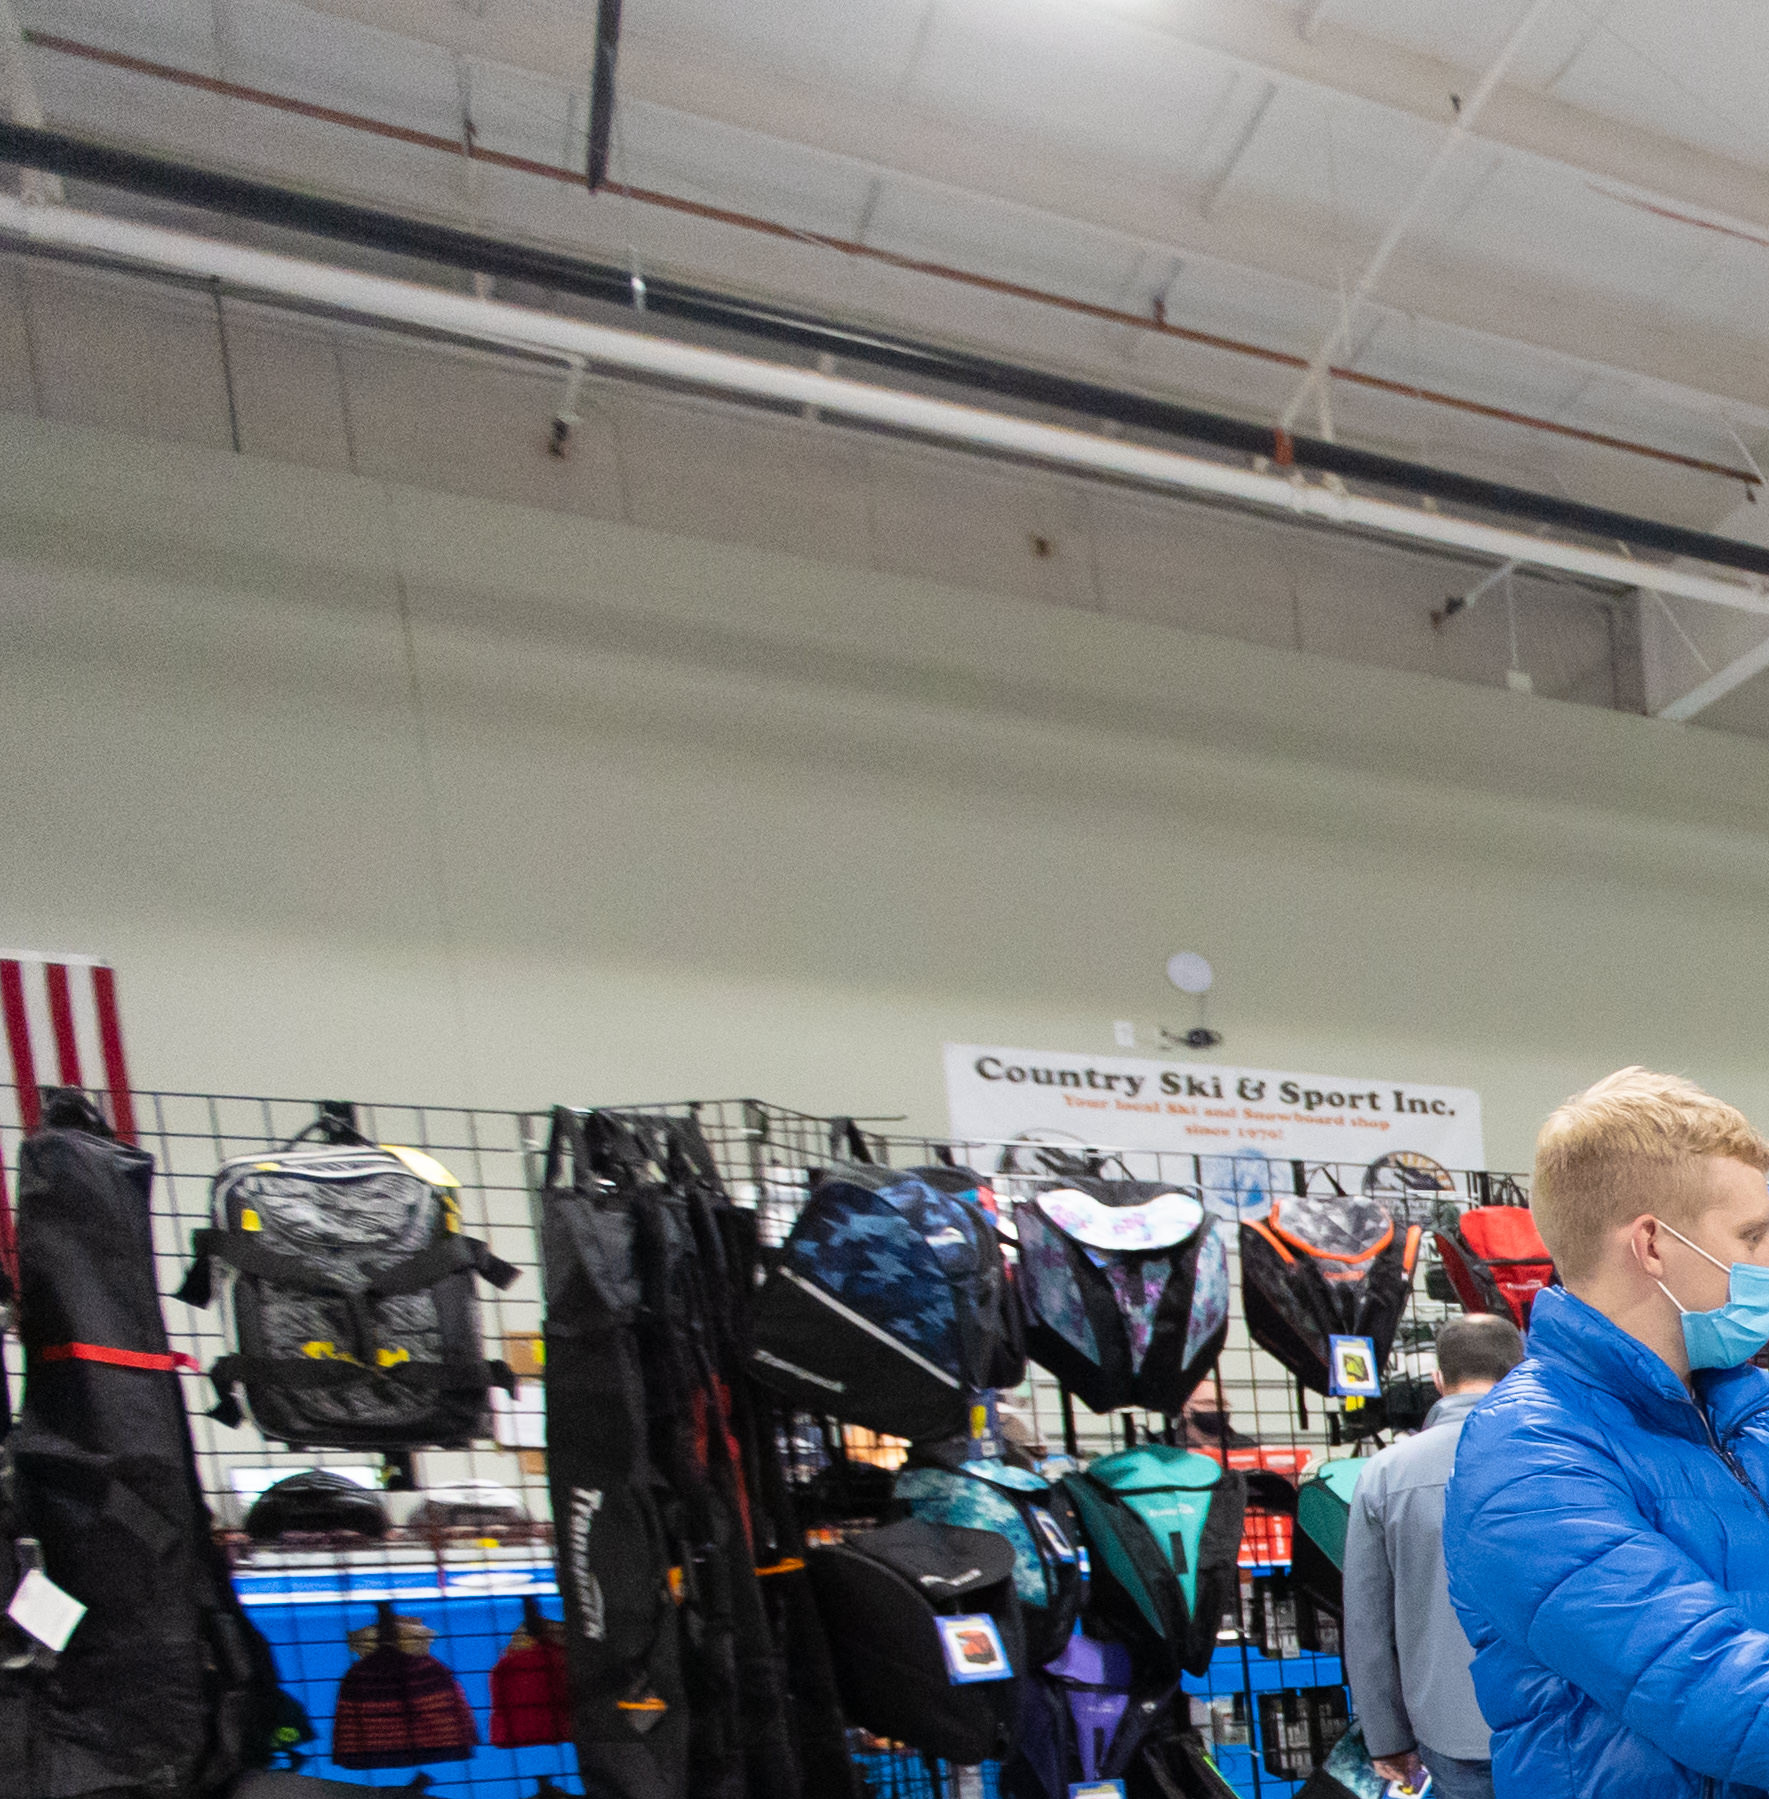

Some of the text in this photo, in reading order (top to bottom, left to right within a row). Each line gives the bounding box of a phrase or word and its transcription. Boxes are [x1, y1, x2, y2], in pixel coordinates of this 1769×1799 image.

[974, 1056, 1456, 1118] Country Ski & Sport Inc.
[1062, 1093, 1391, 1133] Your local Ski and Snowboard shop
[1184, 1121, 1231, 1139] since
